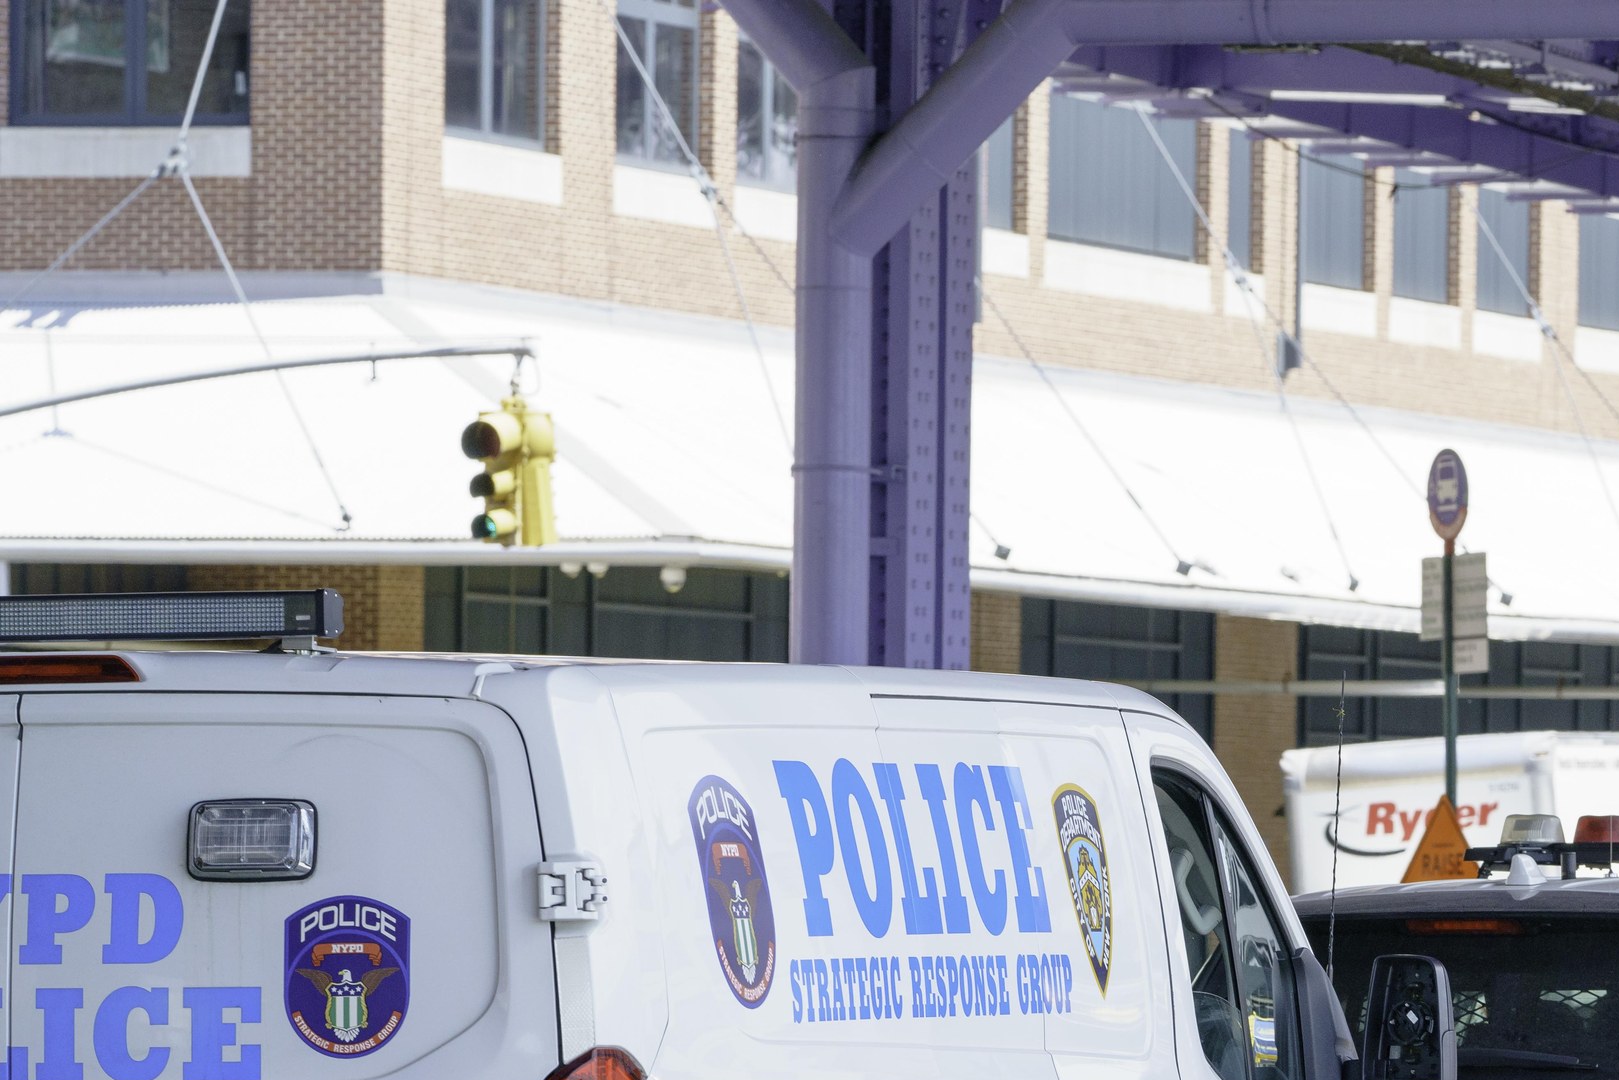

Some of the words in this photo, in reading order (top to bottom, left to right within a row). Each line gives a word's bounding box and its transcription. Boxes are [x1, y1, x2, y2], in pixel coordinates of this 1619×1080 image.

[696, 786, 752, 841] POLICE
[1061, 794, 1089, 821] POLICE
[1366, 802, 1498, 841] Ryer
[720, 843, 740, 857] NYPD
[772, 757, 1052, 939] POLICE
[1060, 815, 1102, 853] DEPARTMENT
[0, 873, 184, 965] PD
[300, 903, 397, 943] POLICE
[331, 943, 364, 954] NYPD
[790, 955, 903, 1024] STRATEGIC
[908, 954, 1011, 1019] RESPONSE
[1016, 953, 1073, 1016] GROUP
[294, 1015, 331, 1050] STRATEGIC
[333, 1038, 377, 1054] RESPONSE
[377, 1015, 399, 1041] GROUP
